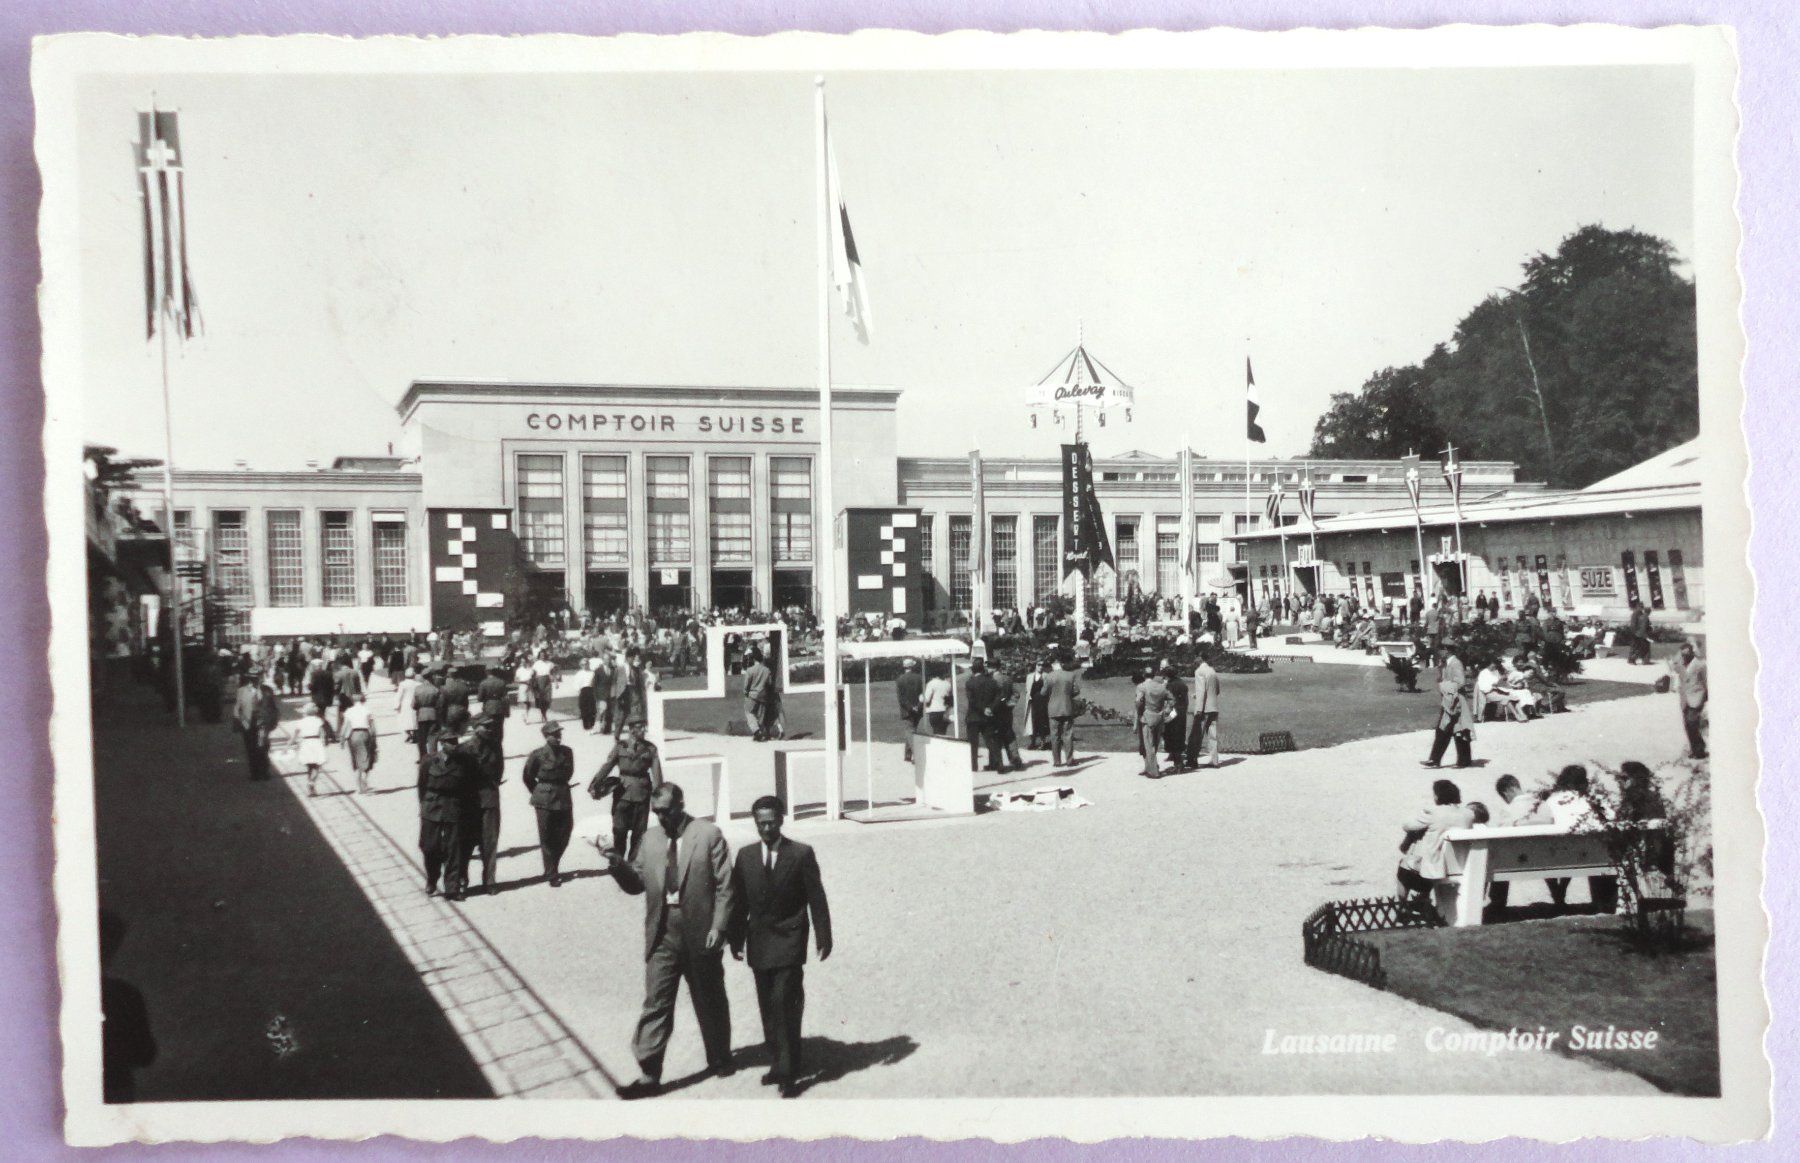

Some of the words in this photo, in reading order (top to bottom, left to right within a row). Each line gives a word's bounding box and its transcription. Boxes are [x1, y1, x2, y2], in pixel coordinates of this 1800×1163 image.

[527, 413, 676, 432] COMPTOIR
[699, 416, 804, 434] SUISSE
[1071, 452, 1080, 551] DESSERT
[1581, 571, 1612, 588] SUZE
